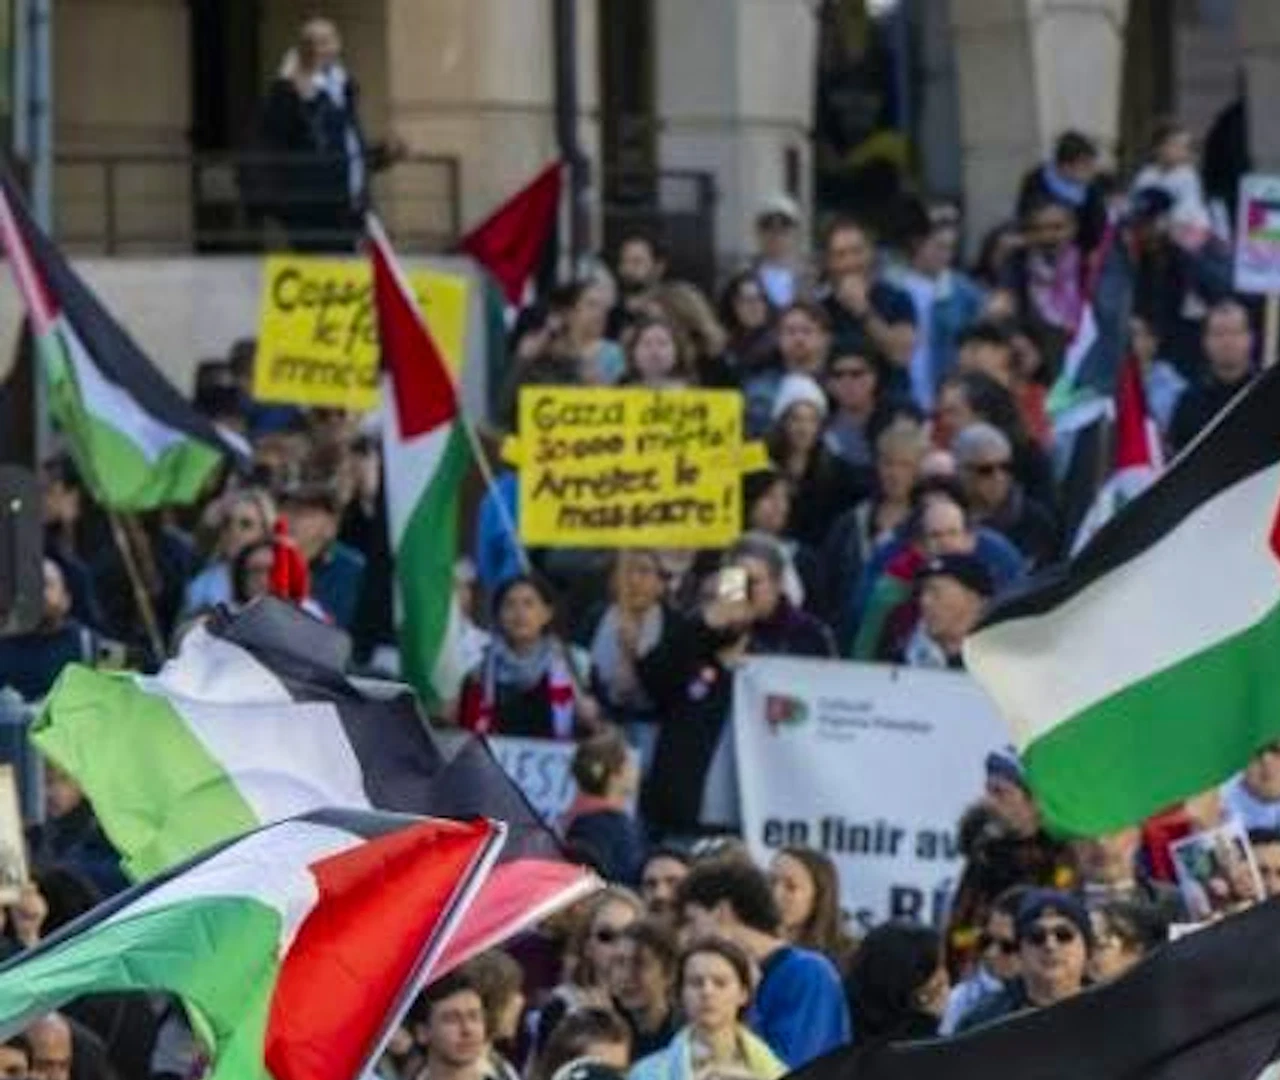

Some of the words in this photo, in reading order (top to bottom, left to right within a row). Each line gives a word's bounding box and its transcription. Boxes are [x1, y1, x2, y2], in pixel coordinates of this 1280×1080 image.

[533, 396, 624, 431] Gaza
[763, 816, 809, 849] en
[818, 815, 906, 856] finir
